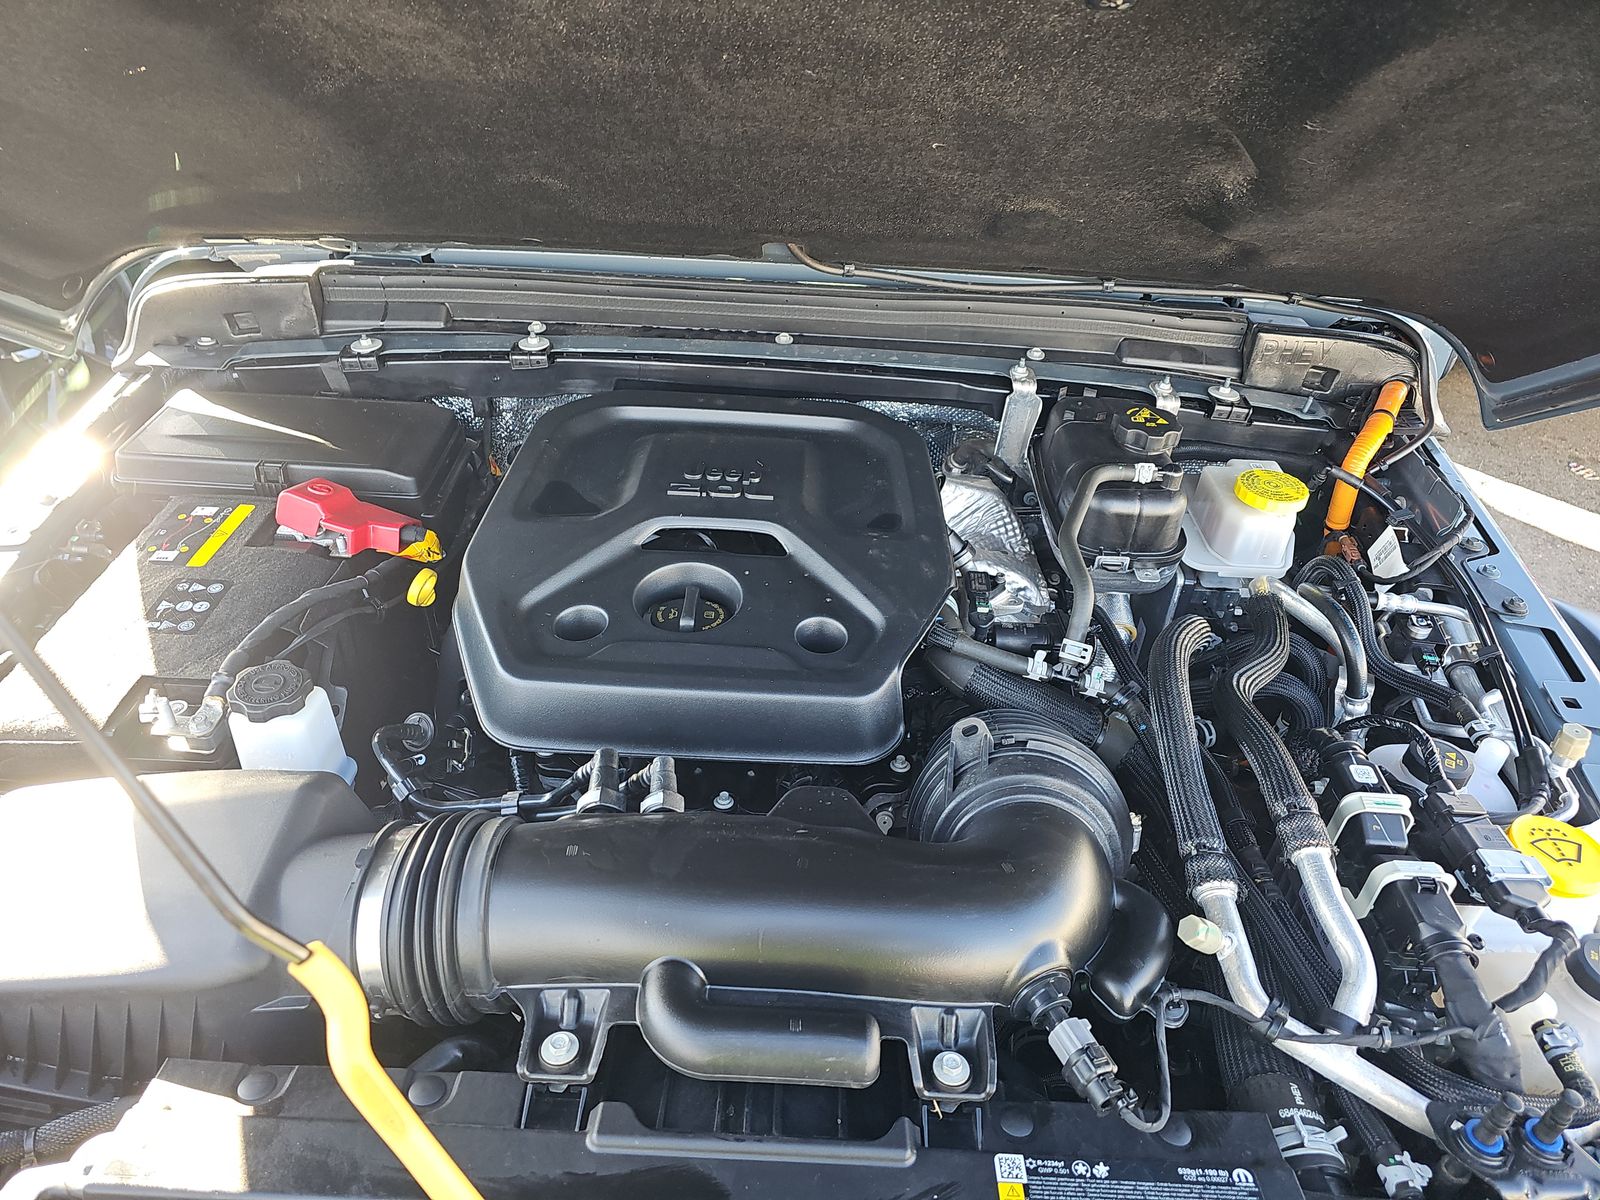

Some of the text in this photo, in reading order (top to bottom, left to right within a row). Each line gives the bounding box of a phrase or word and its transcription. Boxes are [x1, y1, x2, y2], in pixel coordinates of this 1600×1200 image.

[1254, 339, 1339, 366] PHEV
[683, 460, 764, 486] Jeep
[667, 482, 774, 501] 2.0L
[1289, 1082, 1305, 1105] PHEV
